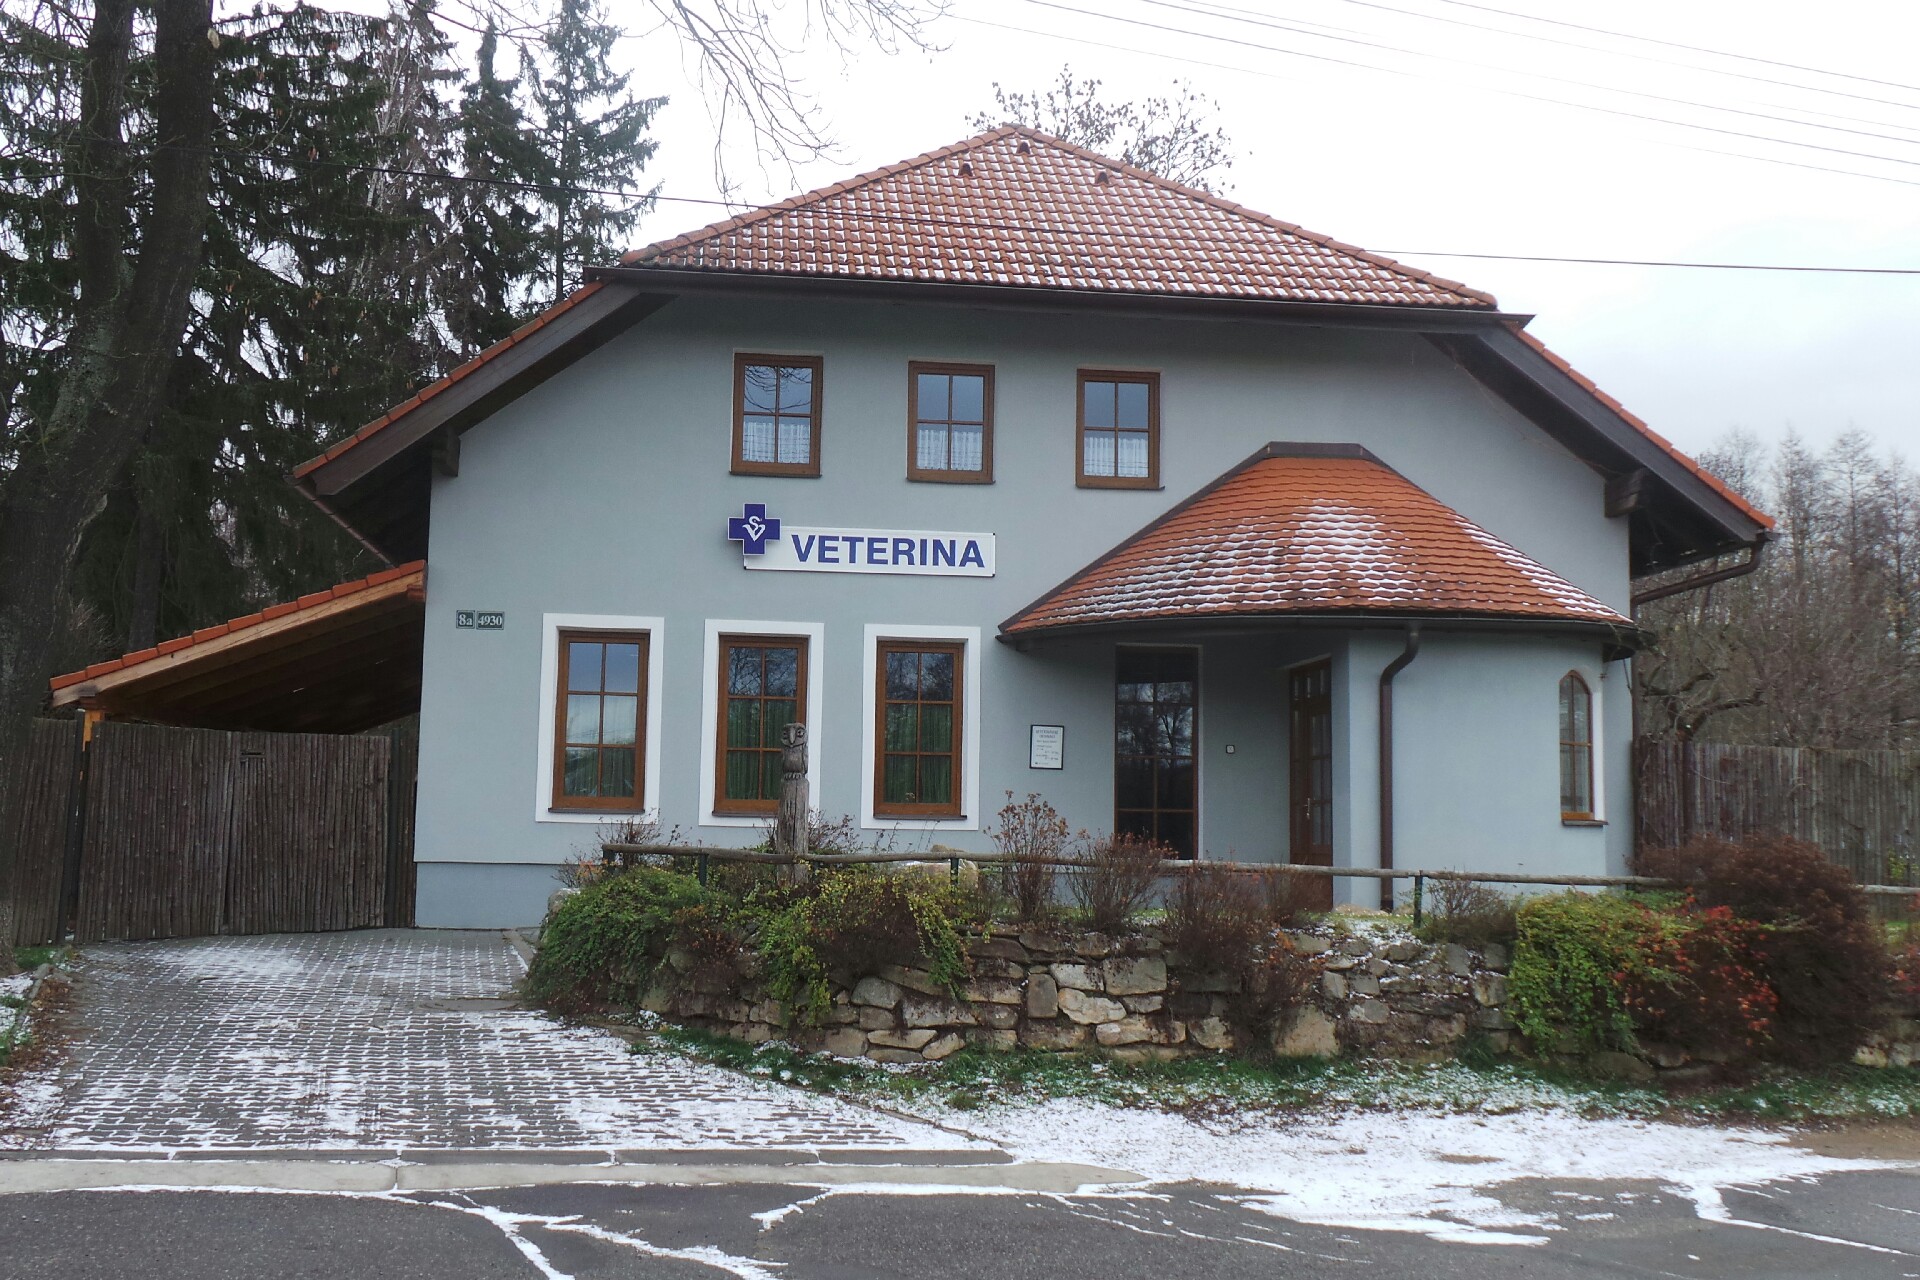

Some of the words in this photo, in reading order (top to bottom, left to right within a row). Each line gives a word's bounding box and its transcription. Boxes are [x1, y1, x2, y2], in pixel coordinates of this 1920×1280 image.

[791, 534, 985, 568] VETERINA
[459, 613, 473, 626] 8a
[477, 615, 503, 626] 4930
